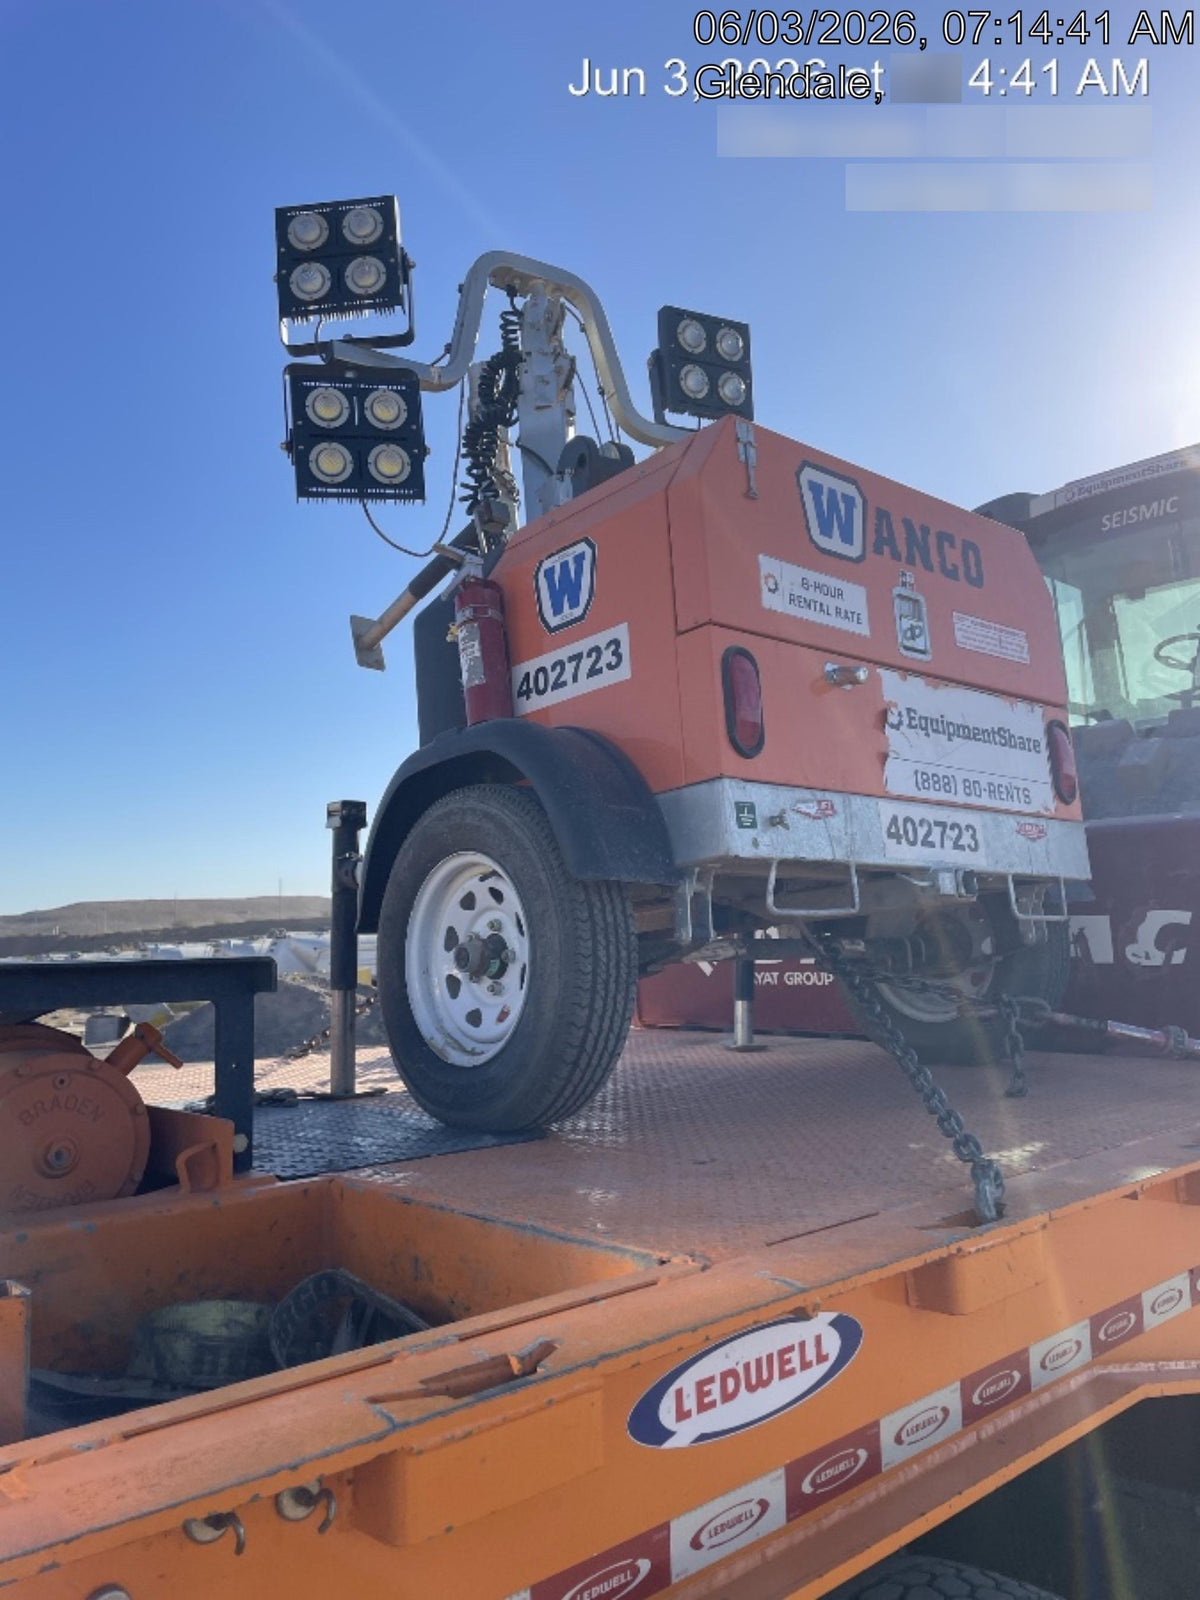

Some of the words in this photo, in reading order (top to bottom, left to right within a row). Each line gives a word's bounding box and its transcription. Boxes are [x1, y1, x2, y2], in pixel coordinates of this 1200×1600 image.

[1101, 496, 1179, 531] SEISMIC
[543, 551, 586, 618] W
[788, 593, 831, 616] RENTAL
[835, 605, 863, 625] RATE
[516, 637, 623, 701] 402723
[906, 707, 1042, 754] EquipmentShare
[914, 769, 958, 796] (888)
[963, 778, 1032, 805] 80-RENTS
[886, 814, 980, 852] 402723
[753, 972, 780, 985] YAT
[783, 972, 834, 986] GROUP
[19, 1094, 104, 1126] BRADEN
[673, 1333, 830, 1424] LEDWELL
[815, 1458, 856, 1484] LEDWELL
[708, 1508, 755, 1540] LEDWELL
[575, 1569, 633, 1600] LEDWELL
